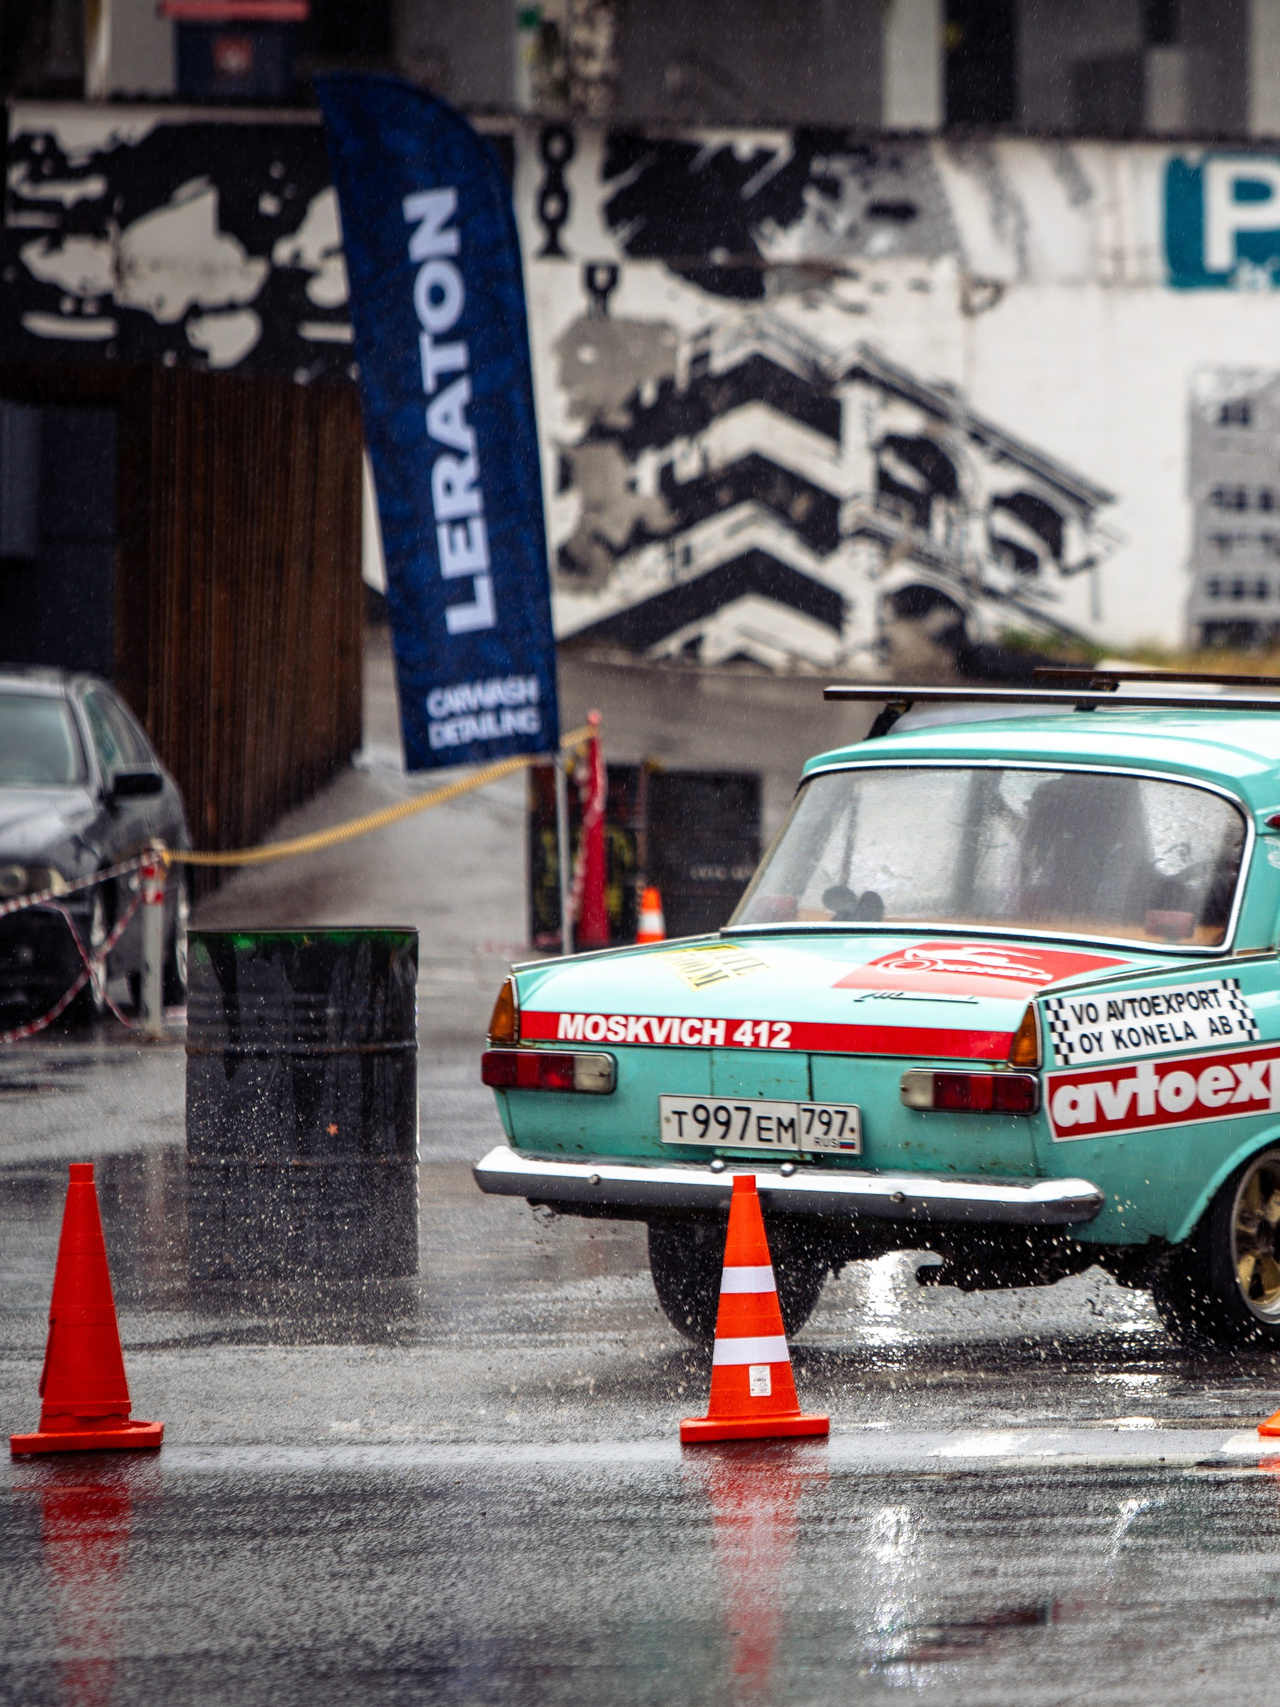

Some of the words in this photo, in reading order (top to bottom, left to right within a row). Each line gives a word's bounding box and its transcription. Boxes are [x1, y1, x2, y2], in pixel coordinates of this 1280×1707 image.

[402, 186, 497, 635] LERATON
[426, 674, 541, 720] CARWASH
[427, 704, 541, 750] DETAILING
[1070, 1002, 1098, 1026] VO
[1106, 987, 1222, 1022] AVTOEXPORT
[557, 1013, 726, 1046] MOSKVICH
[733, 1020, 792, 1049] 412
[1079, 1031, 1104, 1054] OY
[1111, 1020, 1198, 1050] KONELA
[1208, 1015, 1234, 1037] AB
[801, 1107, 848, 1137] 797
[814, 1136, 838, 1148] RUS
